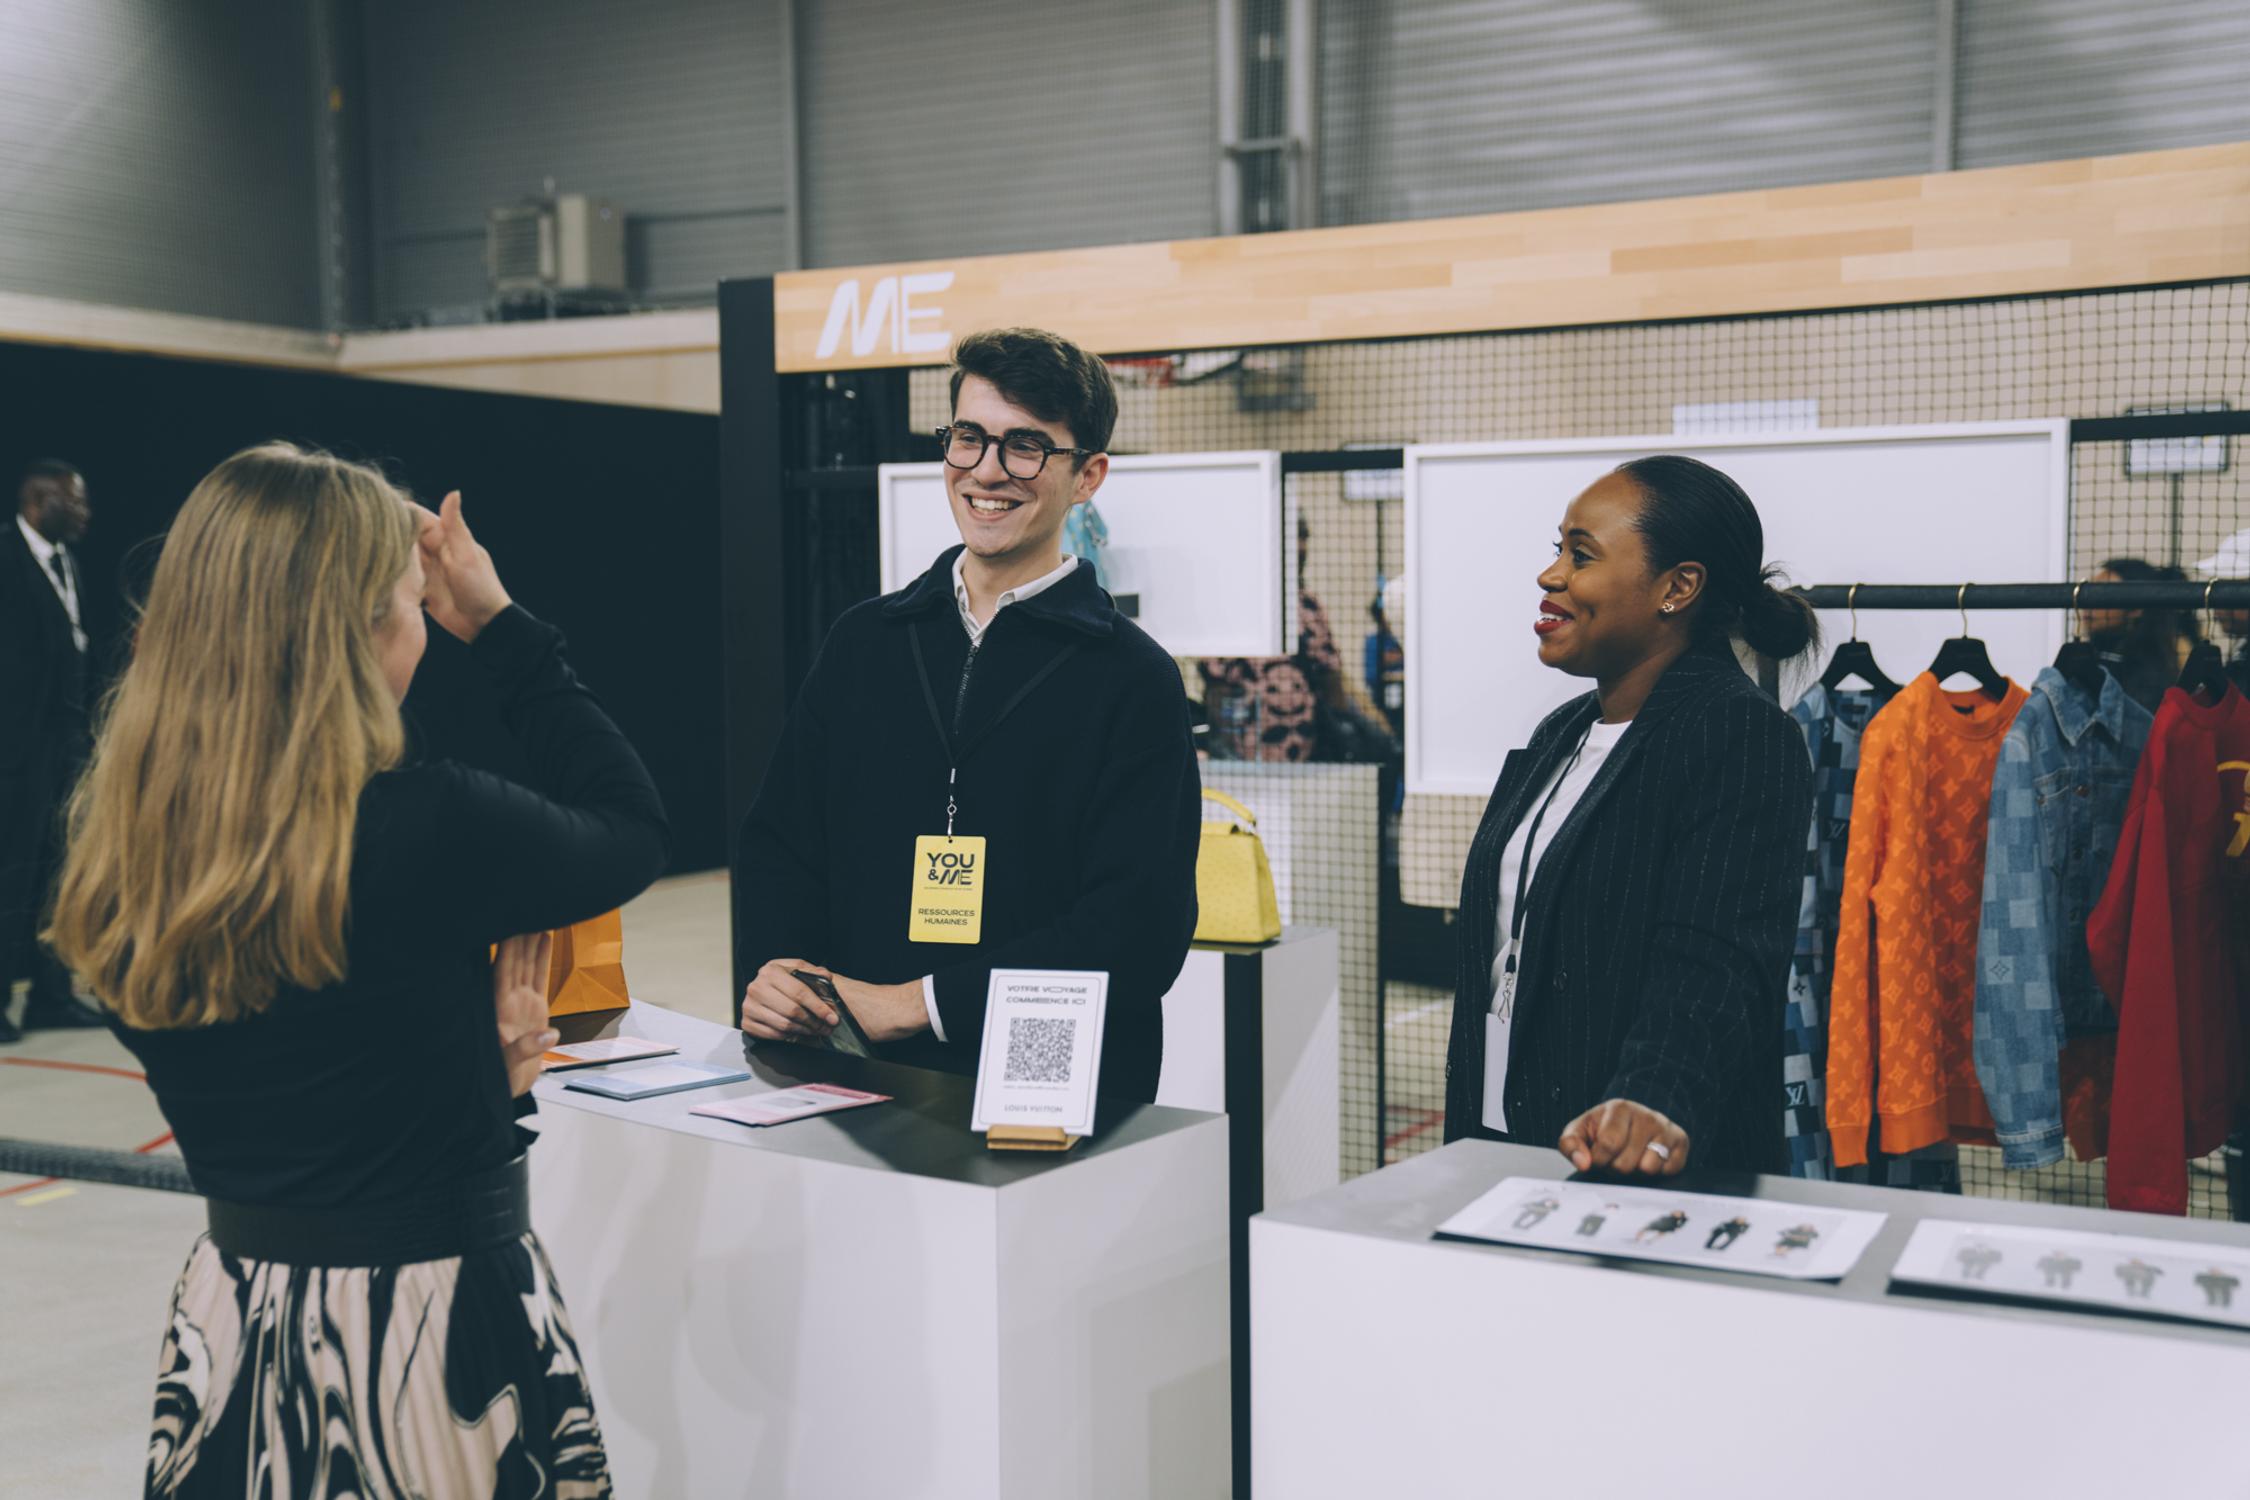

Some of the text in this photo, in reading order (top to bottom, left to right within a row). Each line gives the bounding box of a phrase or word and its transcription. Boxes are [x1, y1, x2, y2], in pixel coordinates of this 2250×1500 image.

[815, 271, 955, 359] ME
[927, 852, 975, 868] YOU
[918, 908, 975, 917] RESSOURCES
[924, 918, 968, 926] HUMAINES
[1007, 985, 1088, 994] VOTRE VOYAGE
[1006, 996, 1069, 1005] COMMENCE
[1004, 1104, 1064, 1113] LOUIS VUITTON
